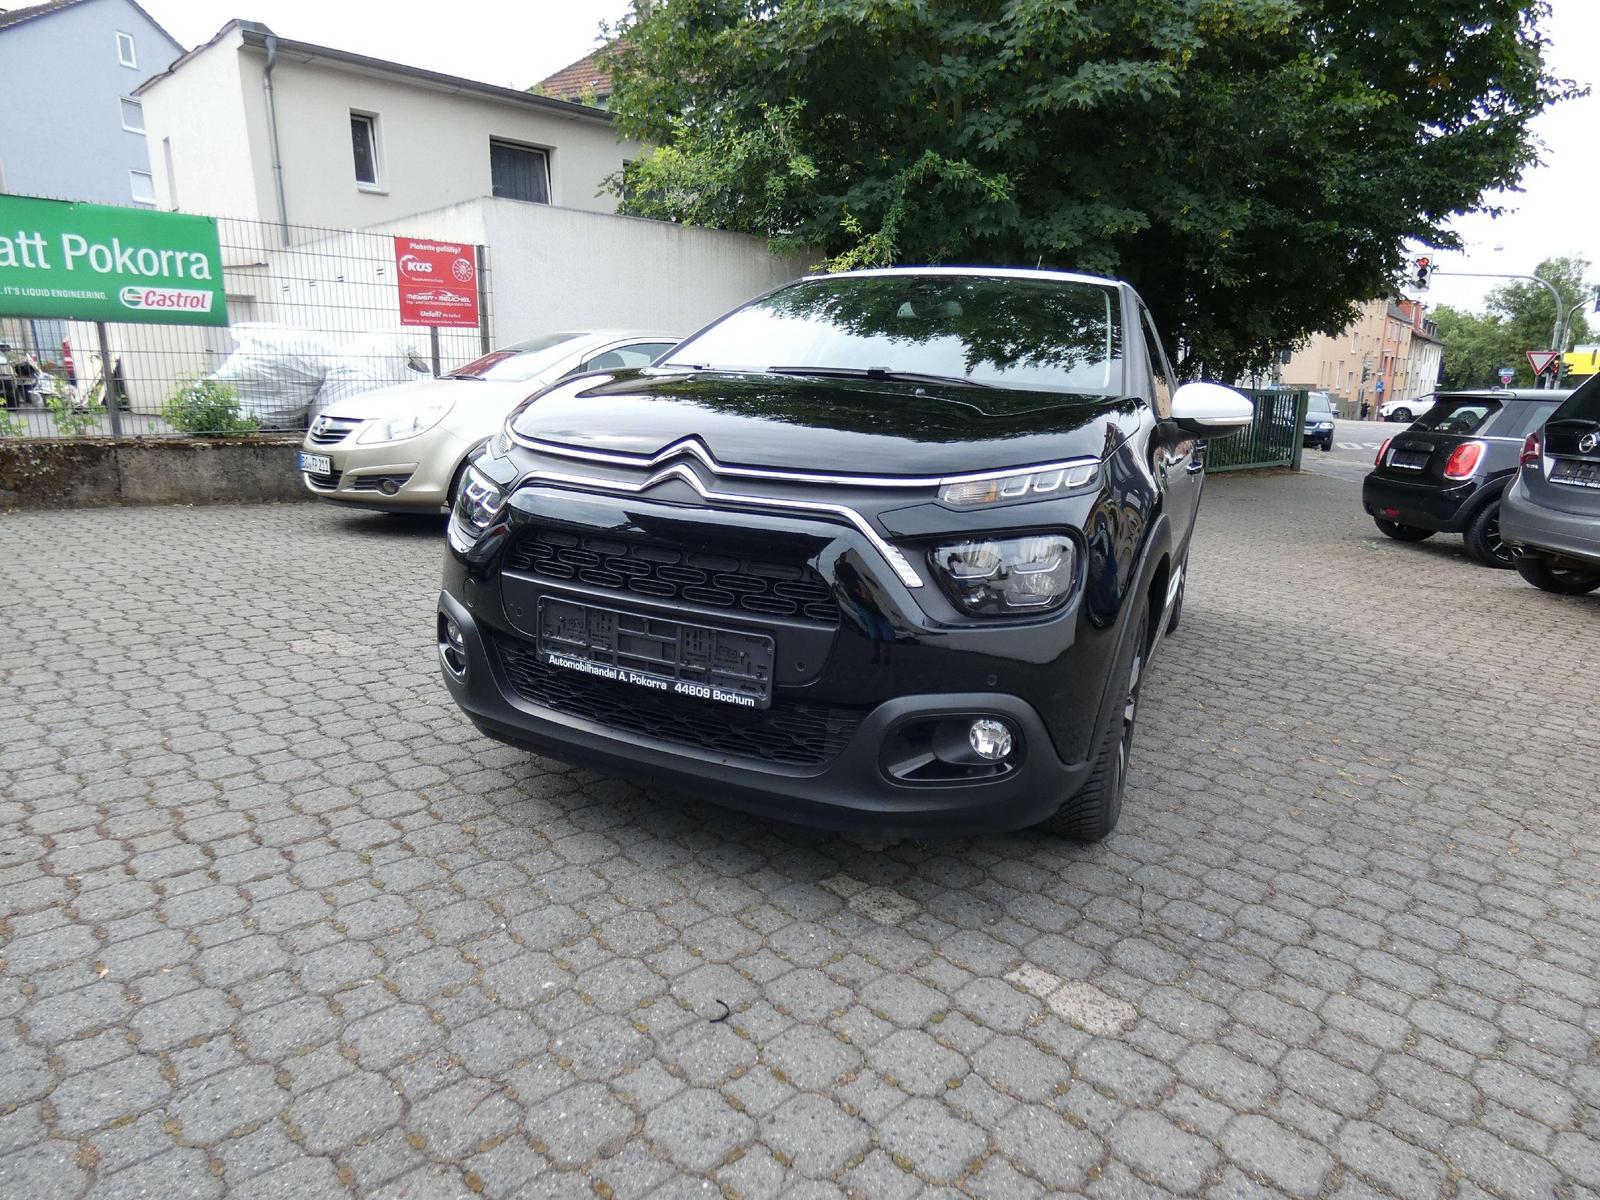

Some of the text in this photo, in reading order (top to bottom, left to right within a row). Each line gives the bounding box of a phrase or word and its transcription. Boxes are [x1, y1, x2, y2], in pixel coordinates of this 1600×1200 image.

[61, 233, 212, 280] Pokorra
[4, 286, 108, 300] IT'S LIQUID ENGINEERING.
[144, 290, 208, 309] Castrol
[548, 654, 755, 707] Automobilhandel A. Pokorra 44809 Bochum
